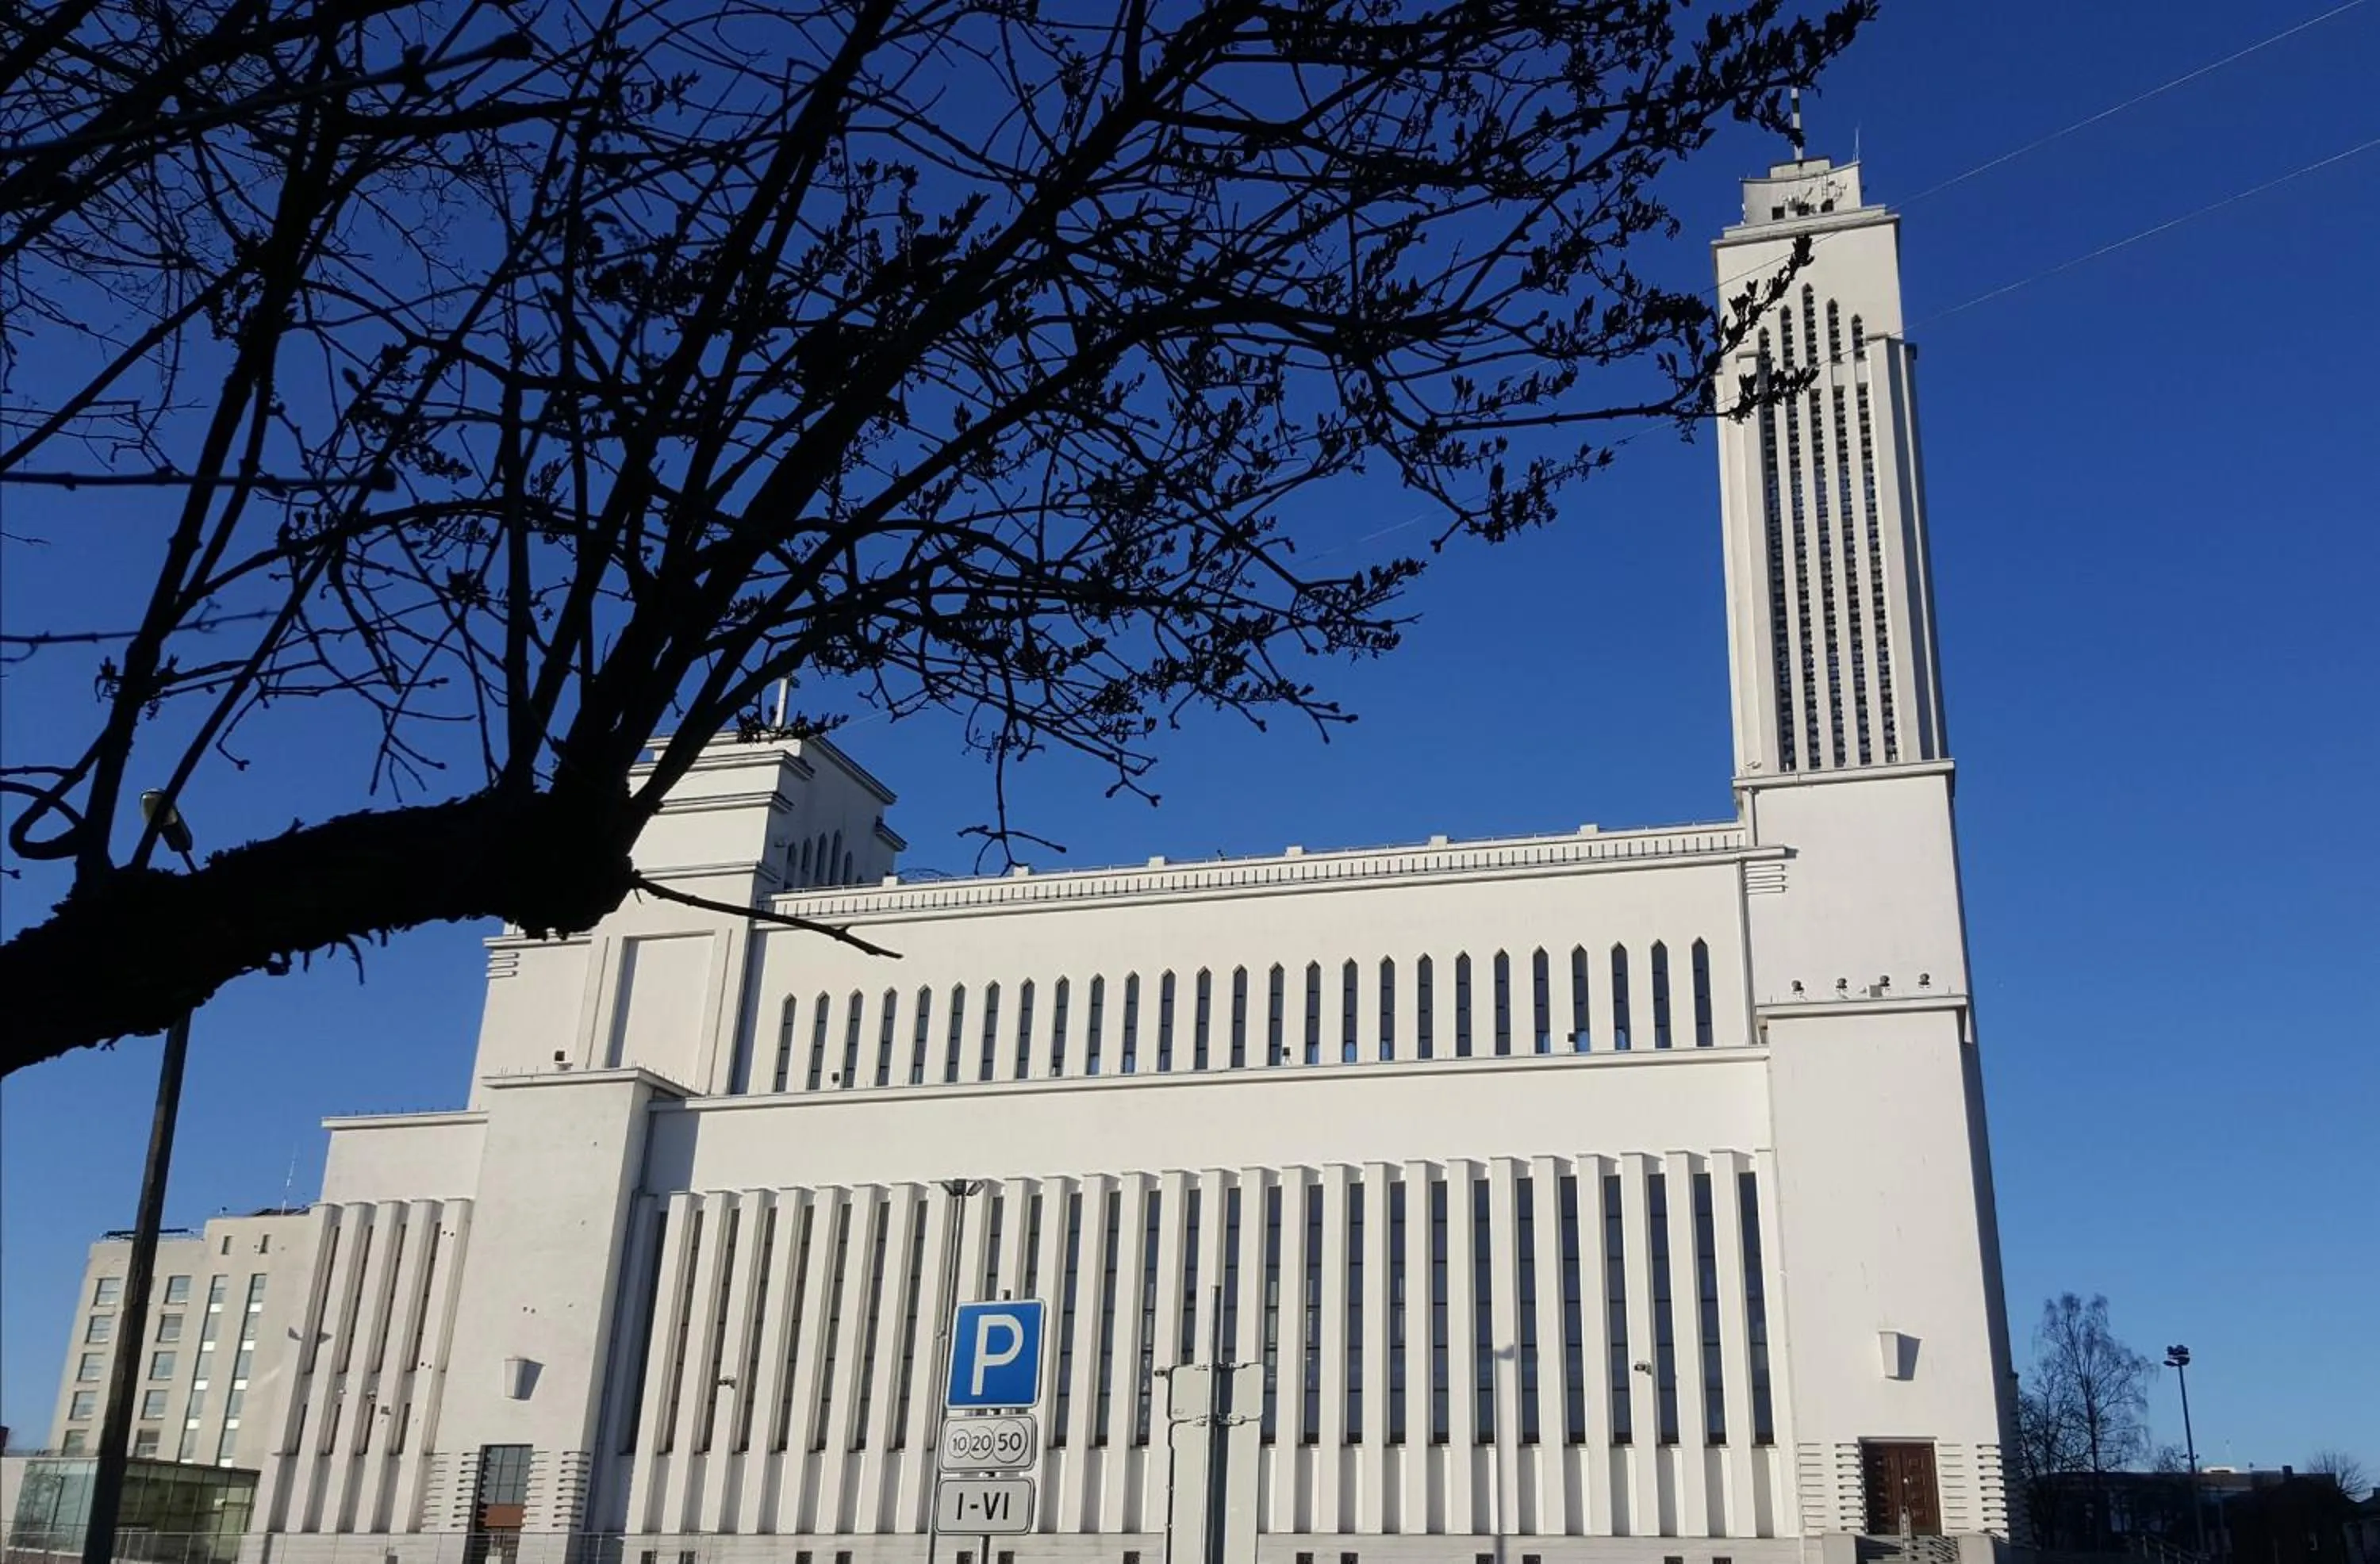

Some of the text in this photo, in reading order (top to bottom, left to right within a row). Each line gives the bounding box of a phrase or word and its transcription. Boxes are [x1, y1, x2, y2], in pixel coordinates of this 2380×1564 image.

[971, 1314, 1023, 1396] P
[952, 1432, 1021, 1451] 10 20 50
[957, 1492, 1009, 1520] I-VI
